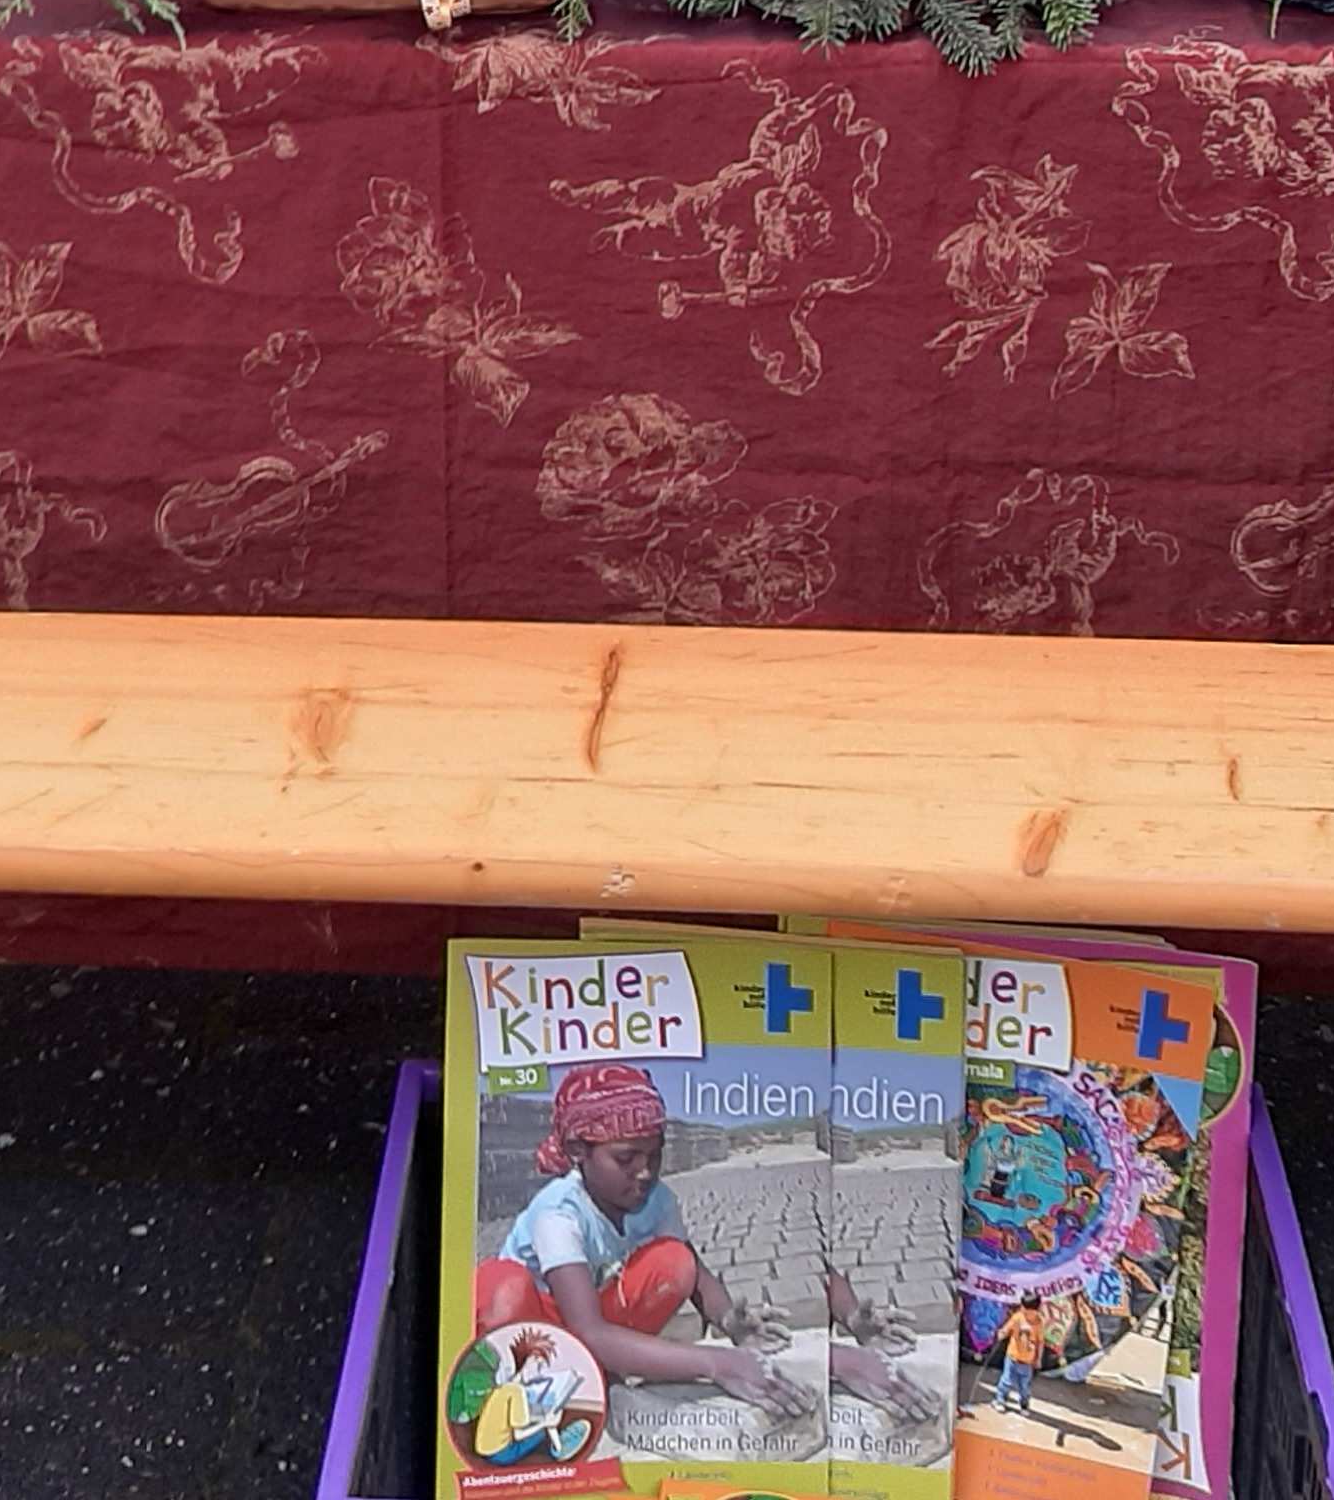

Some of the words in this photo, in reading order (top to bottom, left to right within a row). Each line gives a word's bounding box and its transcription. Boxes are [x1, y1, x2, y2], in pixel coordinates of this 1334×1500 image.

[484, 958, 670, 1010] Kinder
[966, 960, 1046, 1014] der
[499, 1002, 683, 1056] Kinder
[965, 1002, 1052, 1056] der
[515, 1067, 538, 1085] 30
[684, 1070, 815, 1117] Indien
[830, 1075, 944, 1125] ndien
[627, 1408, 740, 1427] Kinderarbeit
[716, 1435, 732, 1450] in
[737, 1432, 798, 1452] Gefahr
[839, 1432, 855, 1449] in
[860, 1434, 922, 1456] Gefahr
